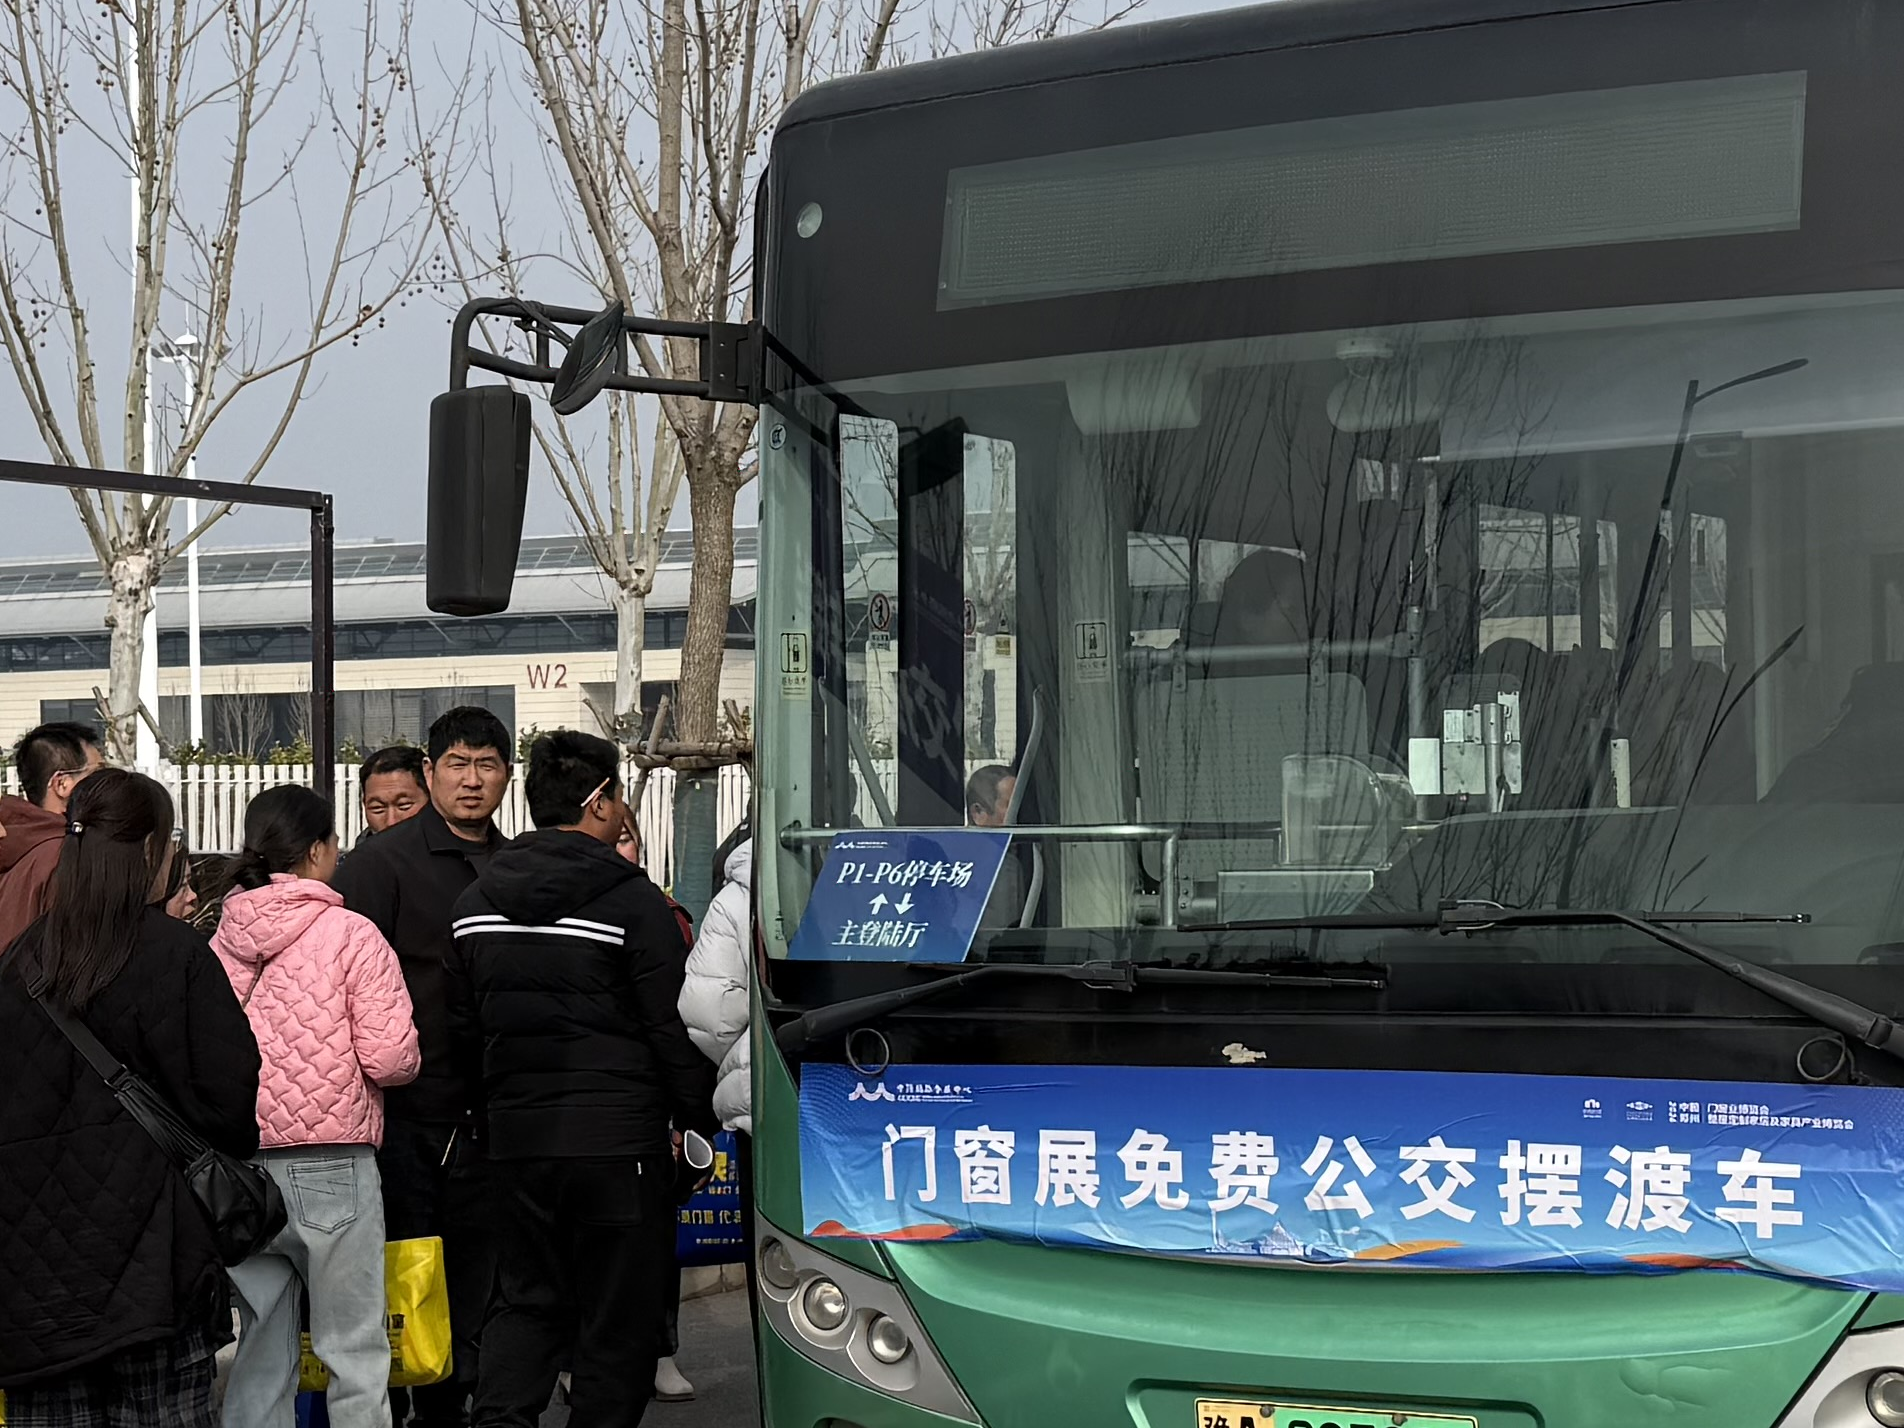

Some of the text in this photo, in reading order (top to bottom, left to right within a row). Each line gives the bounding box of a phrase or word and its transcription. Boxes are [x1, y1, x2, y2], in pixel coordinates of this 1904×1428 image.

[527, 663, 568, 689] W2
[836, 859, 974, 888] P1-P6停车场
[831, 920, 930, 948] 主登陆厅
[882, 1123, 1804, 1240] 门窗展免费公交摆渡车
